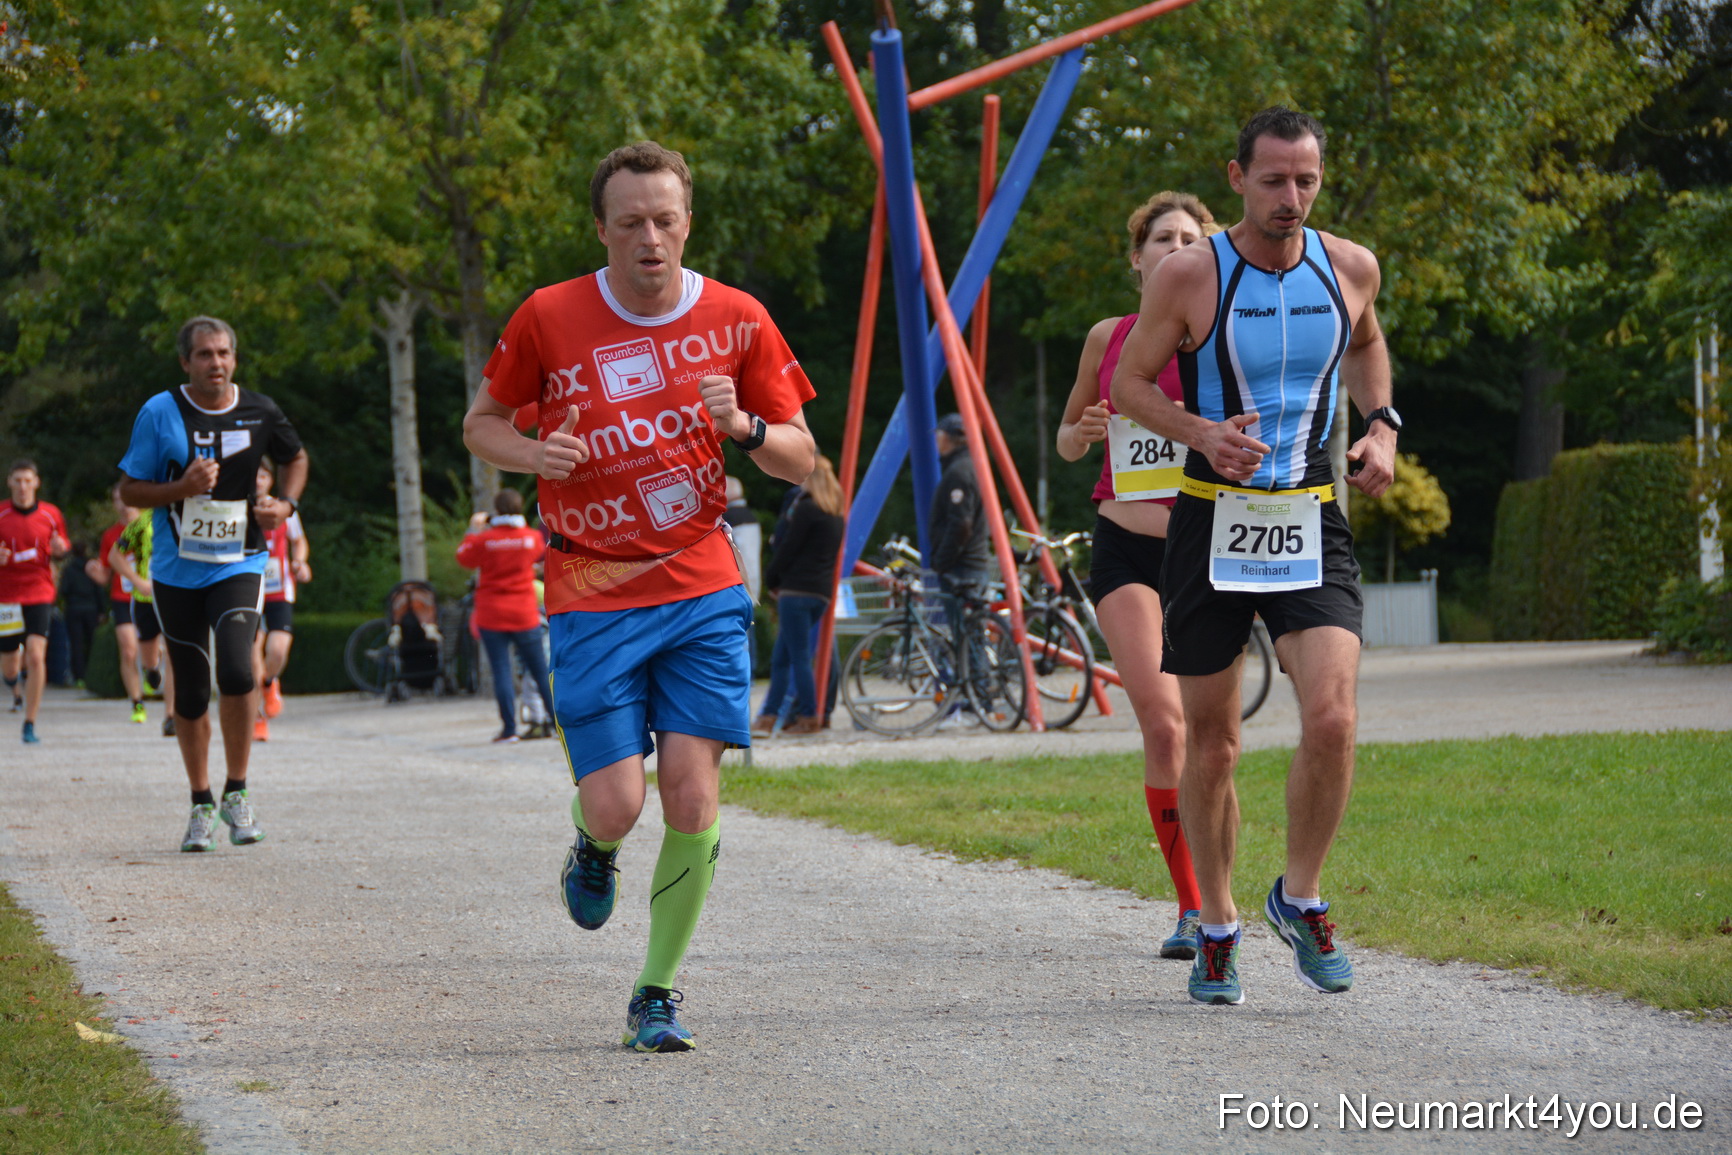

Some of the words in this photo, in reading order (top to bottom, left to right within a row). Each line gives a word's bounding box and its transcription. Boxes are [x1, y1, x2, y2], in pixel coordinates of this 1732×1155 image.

[598, 343, 651, 362] raumbox
[674, 362, 732, 386] schenken
[555, 399, 592, 419] outdor
[551, 470, 594, 490] schenken
[602, 453, 655, 476] wohnen
[663, 435, 707, 458] outdoor
[1129, 438, 1176, 466] 284
[641, 470, 688, 493] raumbox
[1257, 503, 1291, 513] BOCK
[192, 519, 237, 538] 2134
[593, 528, 641, 549] outdoor
[1228, 523, 1304, 555] 2705
[1241, 565, 1290, 576] Reinhard
